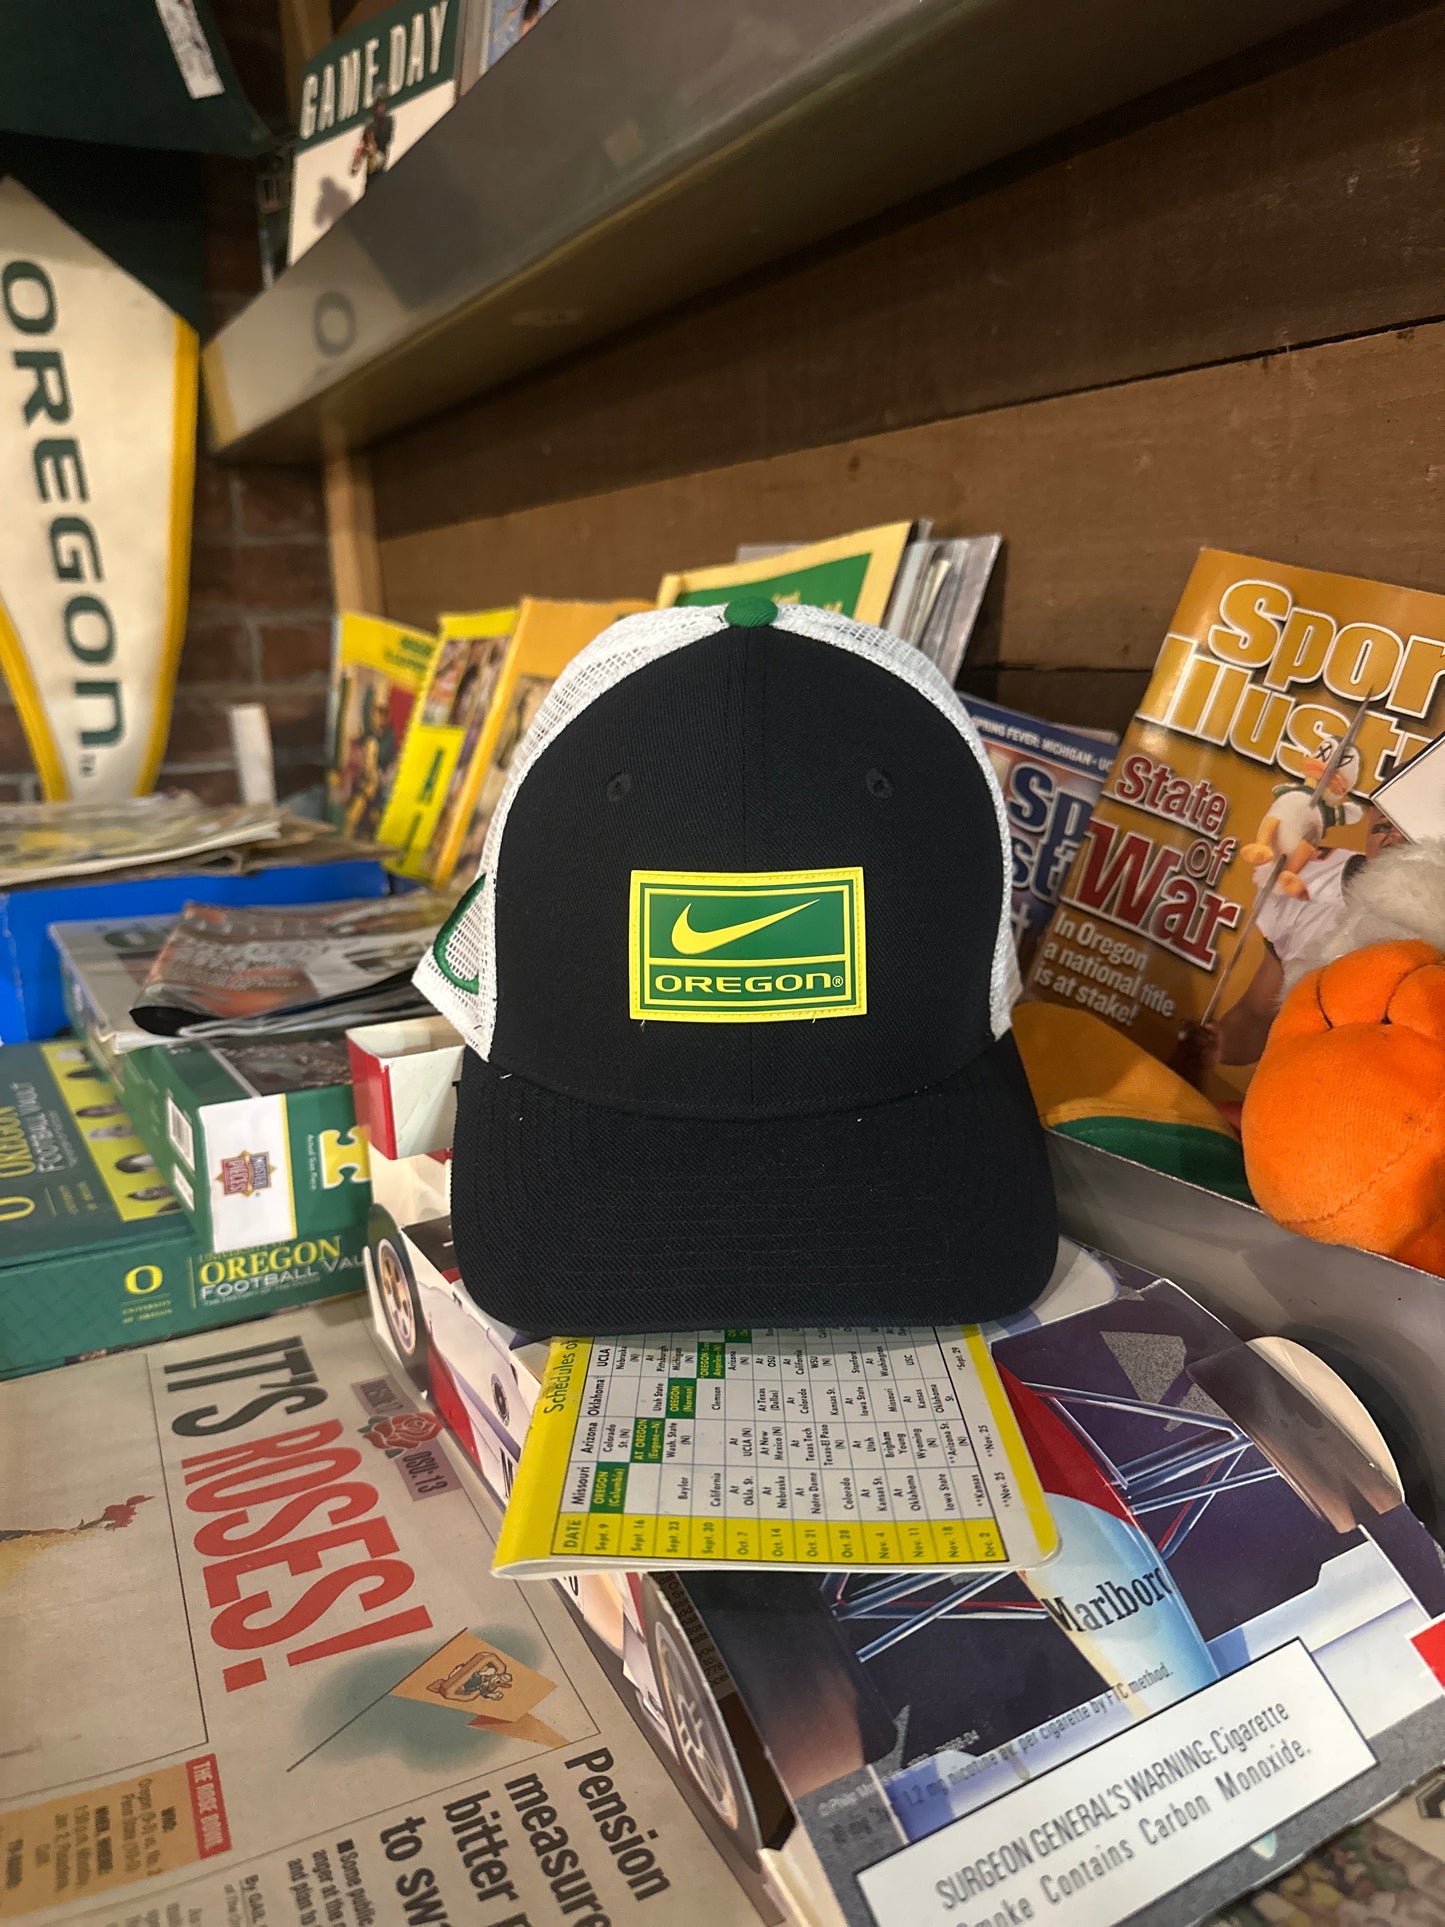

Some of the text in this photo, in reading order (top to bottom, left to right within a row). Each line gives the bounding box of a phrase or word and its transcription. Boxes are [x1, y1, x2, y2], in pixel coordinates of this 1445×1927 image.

[301, 36, 383, 140] GAME
[387, 1, 450, 97] DAY
[0, 259, 127, 750] OREGON
[1135, 633, 1433, 798] Illust
[1115, 753, 1229, 838] State
[1184, 837, 1238, 887] of
[1059, 817, 1242, 972] War
[1054, 911, 1080, 938] In
[1079, 915, 1151, 971] Oregon
[1034, 963, 1140, 1028] is at stake!
[1044, 943, 1177, 1020] a national title
[229, 1159, 248, 1193] PIECES
[200, 1235, 341, 1285] OREGON
[124, 1265, 163, 1295] O
[201, 1266, 320, 1300] FOOTBALL
[597, 1348, 611, 1367] UCLA
[616, 1345, 628, 1369] Nebraska
[656, 1345, 669, 1372] Pittsburgh
[673, 1347, 684, 1370] Michigan
[728, 1351, 737, 1371] Arizona
[740, 1356, 750, 1366] (N)
[767, 1355, 776, 1368] OSU
[794, 1350, 804, 1375] California
[810, 1356, 819, 1369] WSU
[850, 1351, 860, 1374] Stanford
[876, 1346, 889, 1377] Washington
[904, 1354, 915, 1366] USC
[164, 1336, 328, 1437] IT'S
[543, 1352, 576, 1414] Schedules
[653, 1383, 664, 1411] Utah State
[757, 1388, 766, 1404] Texas
[587, 1379, 605, 1416] Oklahoma
[669, 1385, 680, 1412] OREGON
[683, 1386, 694, 1412] (Norman)
[712, 1386, 721, 1410] Clemson
[769, 1390, 780, 1411] (Dallas)
[798, 1388, 809, 1414] Colorado
[830, 1398, 839, 1416] Kansas
[857, 1386, 869, 1416] Iowa State
[884, 1388, 898, 1413] Missouri
[916, 1388, 927, 1409] Kansas
[931, 1384, 944, 1413] Oklahoma
[580, 1422, 598, 1454] Arizona
[603, 1424, 616, 1453] Colorado
[635, 1419, 647, 1447] OREGON
[667, 1422, 678, 1438] State
[680, 1435, 691, 1445] (N)
[742, 1427, 753, 1457] UCLA (N)
[760, 1431, 769, 1447] New
[773, 1426, 784, 1461] Mexico (N)
[897, 1433, 908, 1455] Young
[912, 1428, 927, 1460] Wyoming
[927, 1437, 939, 1449] (N)
[957, 1435, 969, 1446] (N)
[802, 1427, 815, 1462] Texas Tech
[835, 1439, 847, 1450] (N)
[864, 1437, 876, 1452] Utah
[883, 1431, 896, 1458] Brigham
[402, 1450, 448, 1494] OSU: 13
[571, 1466, 590, 1505] Missouri
[593, 1471, 609, 1504] OREGON
[608, 1468, 625, 1506] (Columbia)
[677, 1477, 691, 1499] Baylor
[710, 1472, 721, 1507] California
[743, 1486, 754, 1506] Okla.
[775, 1475, 787, 1509] Nebraska
[809, 1472, 821, 1514] Notre Dame
[840, 1477, 854, 1510] Colorado
[877, 1486, 888, 1512] Kansas
[906, 1475, 922, 1512] Oklahoma
[939, 1473, 955, 1511] Iowa State
[563, 1520, 582, 1548] DATE
[595, 1531, 610, 1550] Sept.
[666, 1533, 680, 1553] Sept.
[702, 1522, 716, 1554] Sept. 30
[737, 1540, 749, 1555] Oct.
[181, 1419, 434, 1693] ROSES!
[772, 1541, 784, 1557] Oct.
[806, 1541, 818, 1557] Oct.
[841, 1542, 853, 1558] Oct.
[878, 1542, 890, 1559] Nov.
[913, 1541, 925, 1558] Nov.
[948, 1540, 960, 1559] Nov.
[985, 1539, 996, 1558] Dec.
[947, 1753, 1000, 1786] nicotine
[1017, 1733, 1038, 1752] per
[1038, 1704, 1091, 1740] cigarette
[1090, 1698, 1107, 1716] by
[1128, 1662, 1174, 1694] method.
[934, 1699, 1291, 1912] SURGEON GENERAL'S WARNING: Cigarette
[563, 1747, 672, 1902] Pension
[1038, 1836, 1136, 1906] Contains
[1136, 1794, 1213, 1847] Carbon
[1213, 1737, 1313, 1802] Monoxide.
[442, 1789, 520, 1902] bitter
[312, 1849, 334, 1883] anger
[340, 1851, 362, 1888] Some
[379, 1815, 450, 1927] to sw
